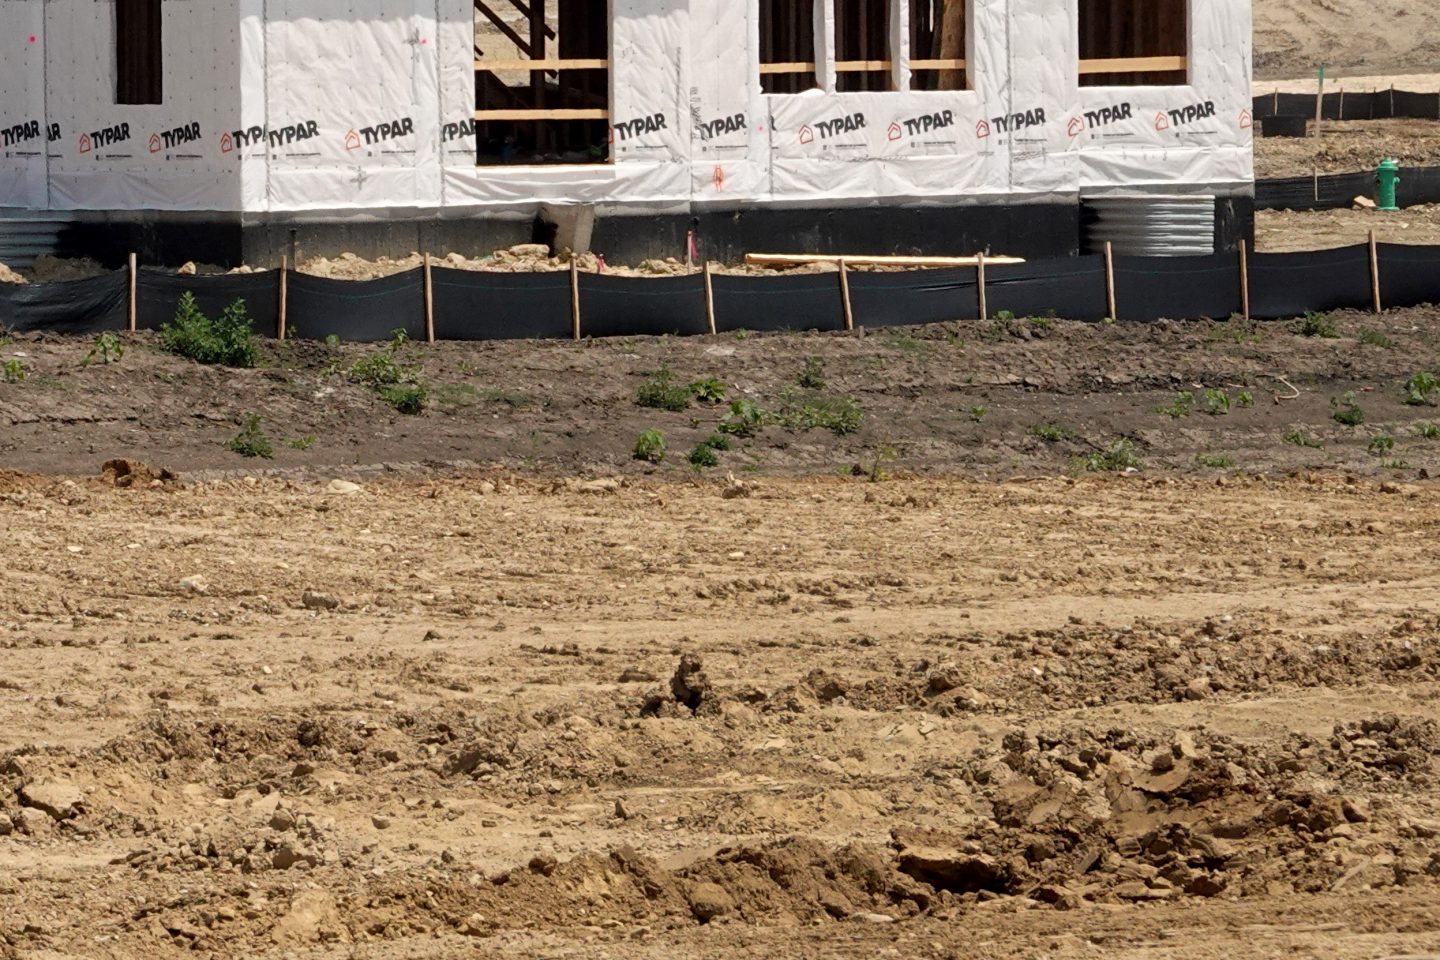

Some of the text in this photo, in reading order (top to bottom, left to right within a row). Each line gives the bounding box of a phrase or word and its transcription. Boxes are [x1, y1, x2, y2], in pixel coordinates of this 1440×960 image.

[613, 113, 667, 141] TYPAR
[814, 112, 866, 139] TYPAR
[904, 110, 954, 136] TYPAR
[1084, 102, 1132, 129] TYPAR
[1168, 101, 1215, 126] TYPAR
[1, 120, 40, 146] TYPAR
[90, 122, 131, 150] TYPAR
[160, 122, 202, 150] TYPAR
[359, 117, 415, 144] TYPAR
